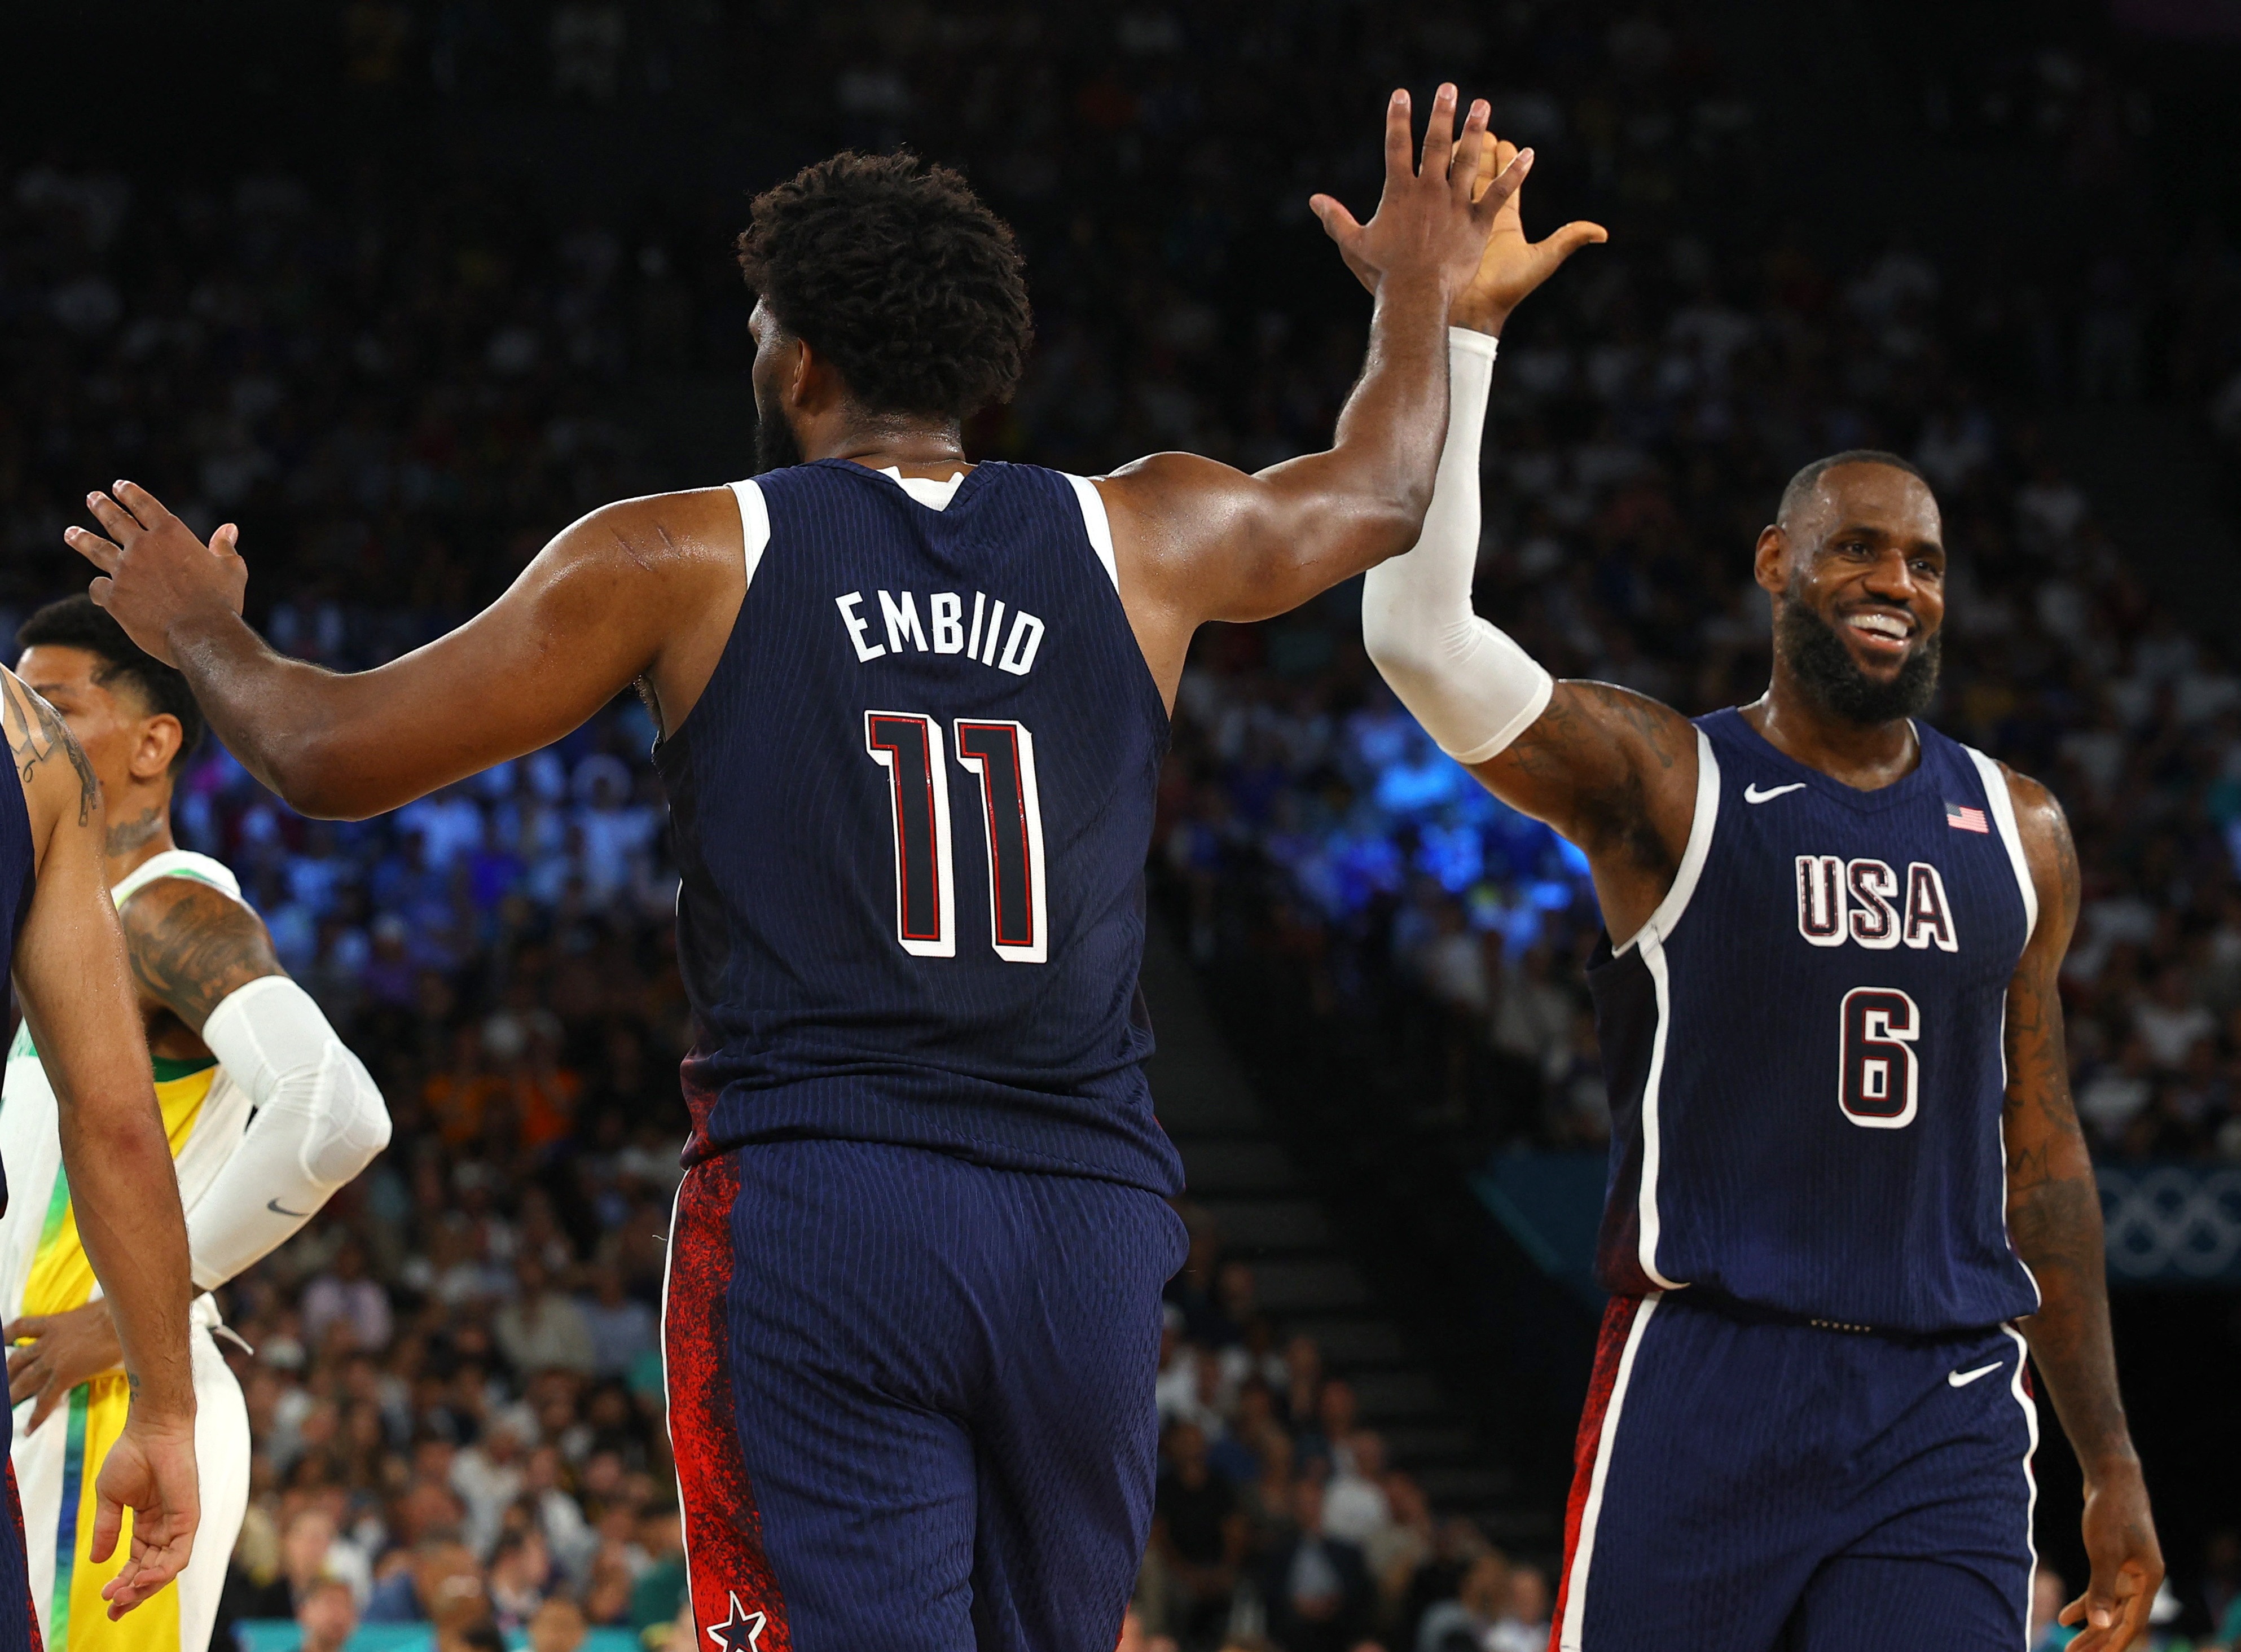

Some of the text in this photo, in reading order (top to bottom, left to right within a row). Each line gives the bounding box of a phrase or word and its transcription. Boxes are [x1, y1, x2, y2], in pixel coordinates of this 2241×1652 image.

[835, 590, 1045, 676] EMBIID
[864, 710, 1047, 964] 11
[1795, 855, 1959, 952] USA
[1838, 986, 1920, 1129] 6
